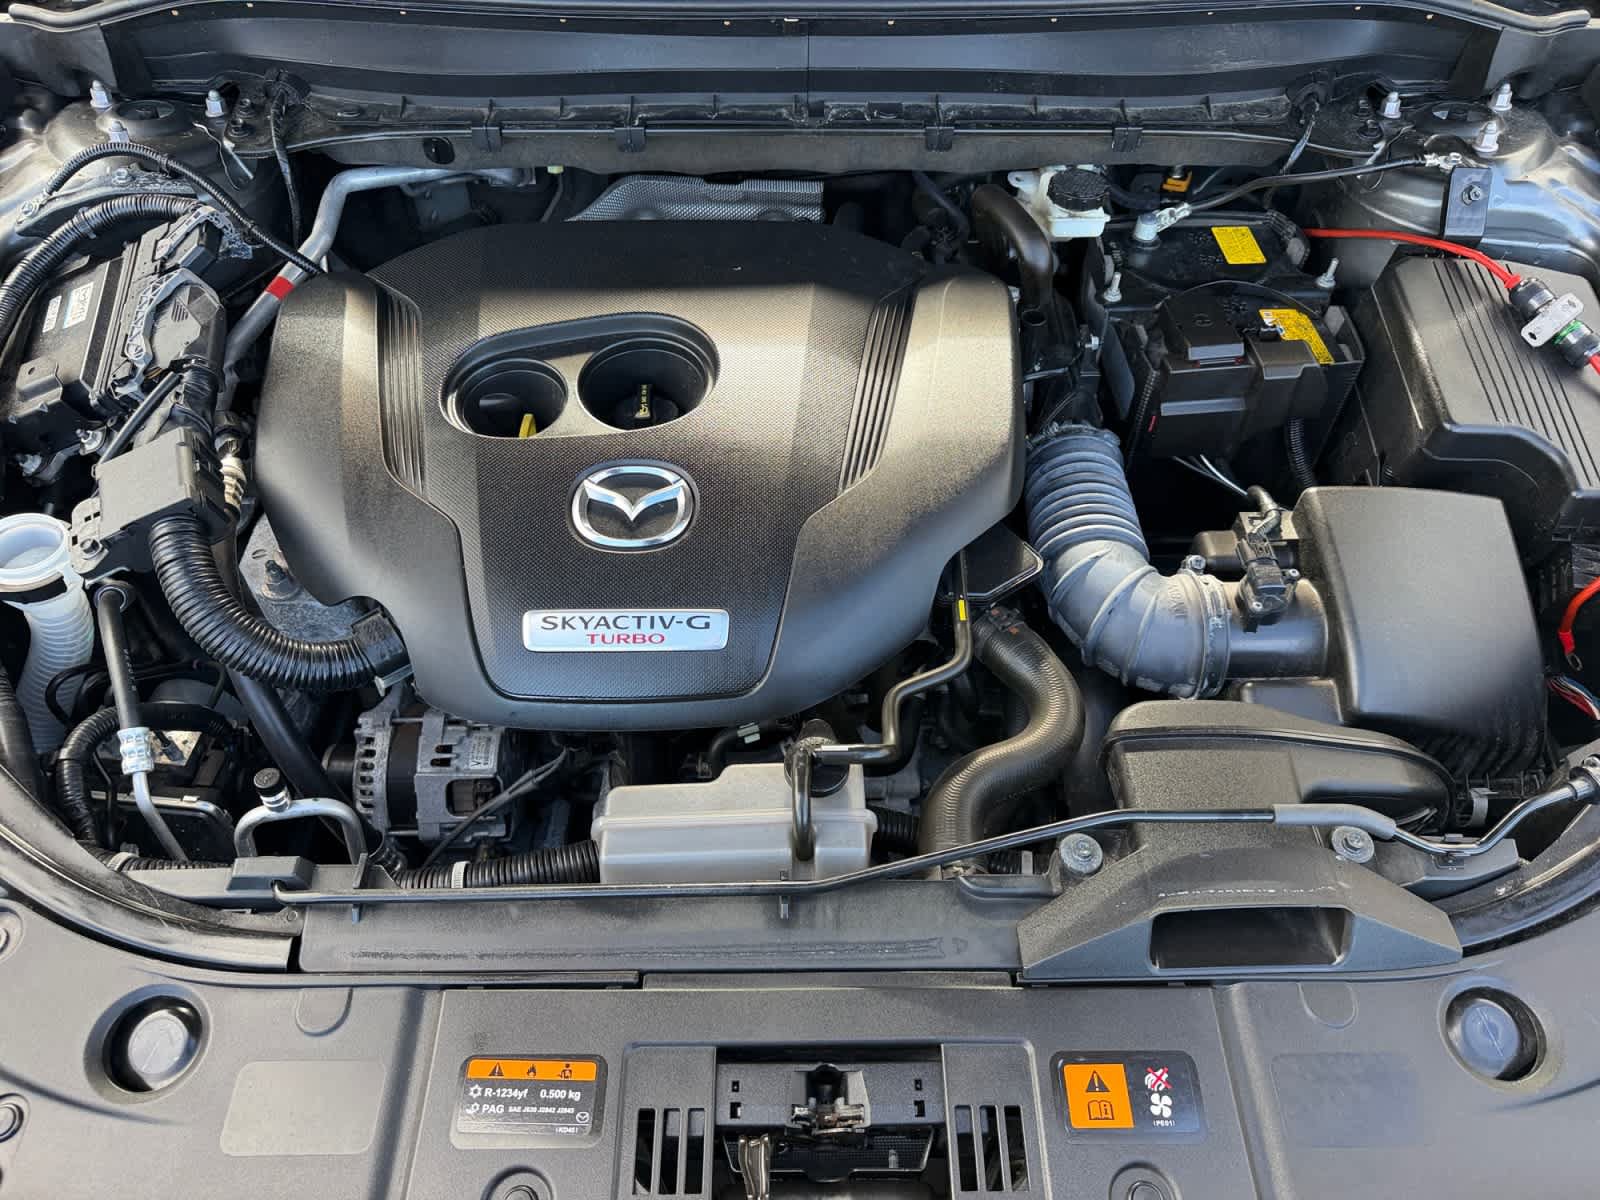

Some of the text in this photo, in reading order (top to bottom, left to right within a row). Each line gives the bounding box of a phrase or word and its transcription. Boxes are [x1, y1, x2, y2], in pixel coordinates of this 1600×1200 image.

[540, 615, 711, 631] SKYACTIV-G
[586, 633, 665, 645] TURBO
[484, 1087, 581, 1102] R-1234yf 0.500 kg
[482, 1104, 505, 1114] PAG
